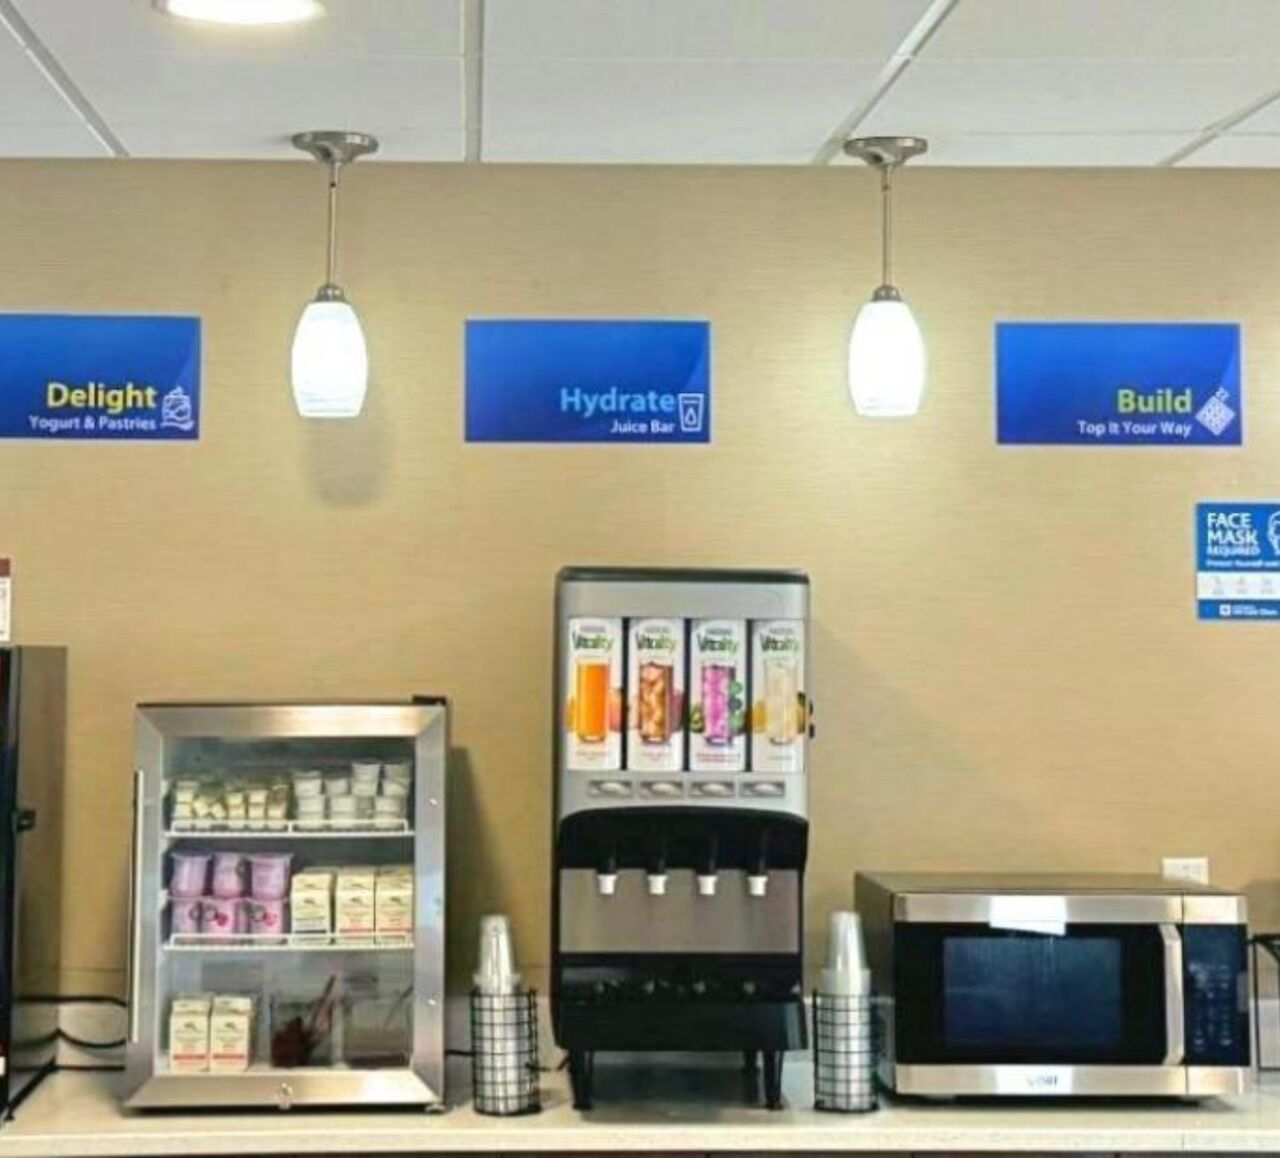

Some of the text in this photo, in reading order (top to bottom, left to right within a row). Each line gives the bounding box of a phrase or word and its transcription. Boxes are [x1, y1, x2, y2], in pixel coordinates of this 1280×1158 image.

[46, 382, 157, 414] Delight
[560, 386, 676, 418] Hydrate
[1117, 387, 1192, 413] Build
[29, 416, 156, 432] Yogurt & Pastries
[610, 420, 676, 433] Juice Bar
[1077, 421, 1192, 438] Top It Your Way
[1207, 513, 1252, 528] FACE
[1207, 529, 1258, 545] MASK
